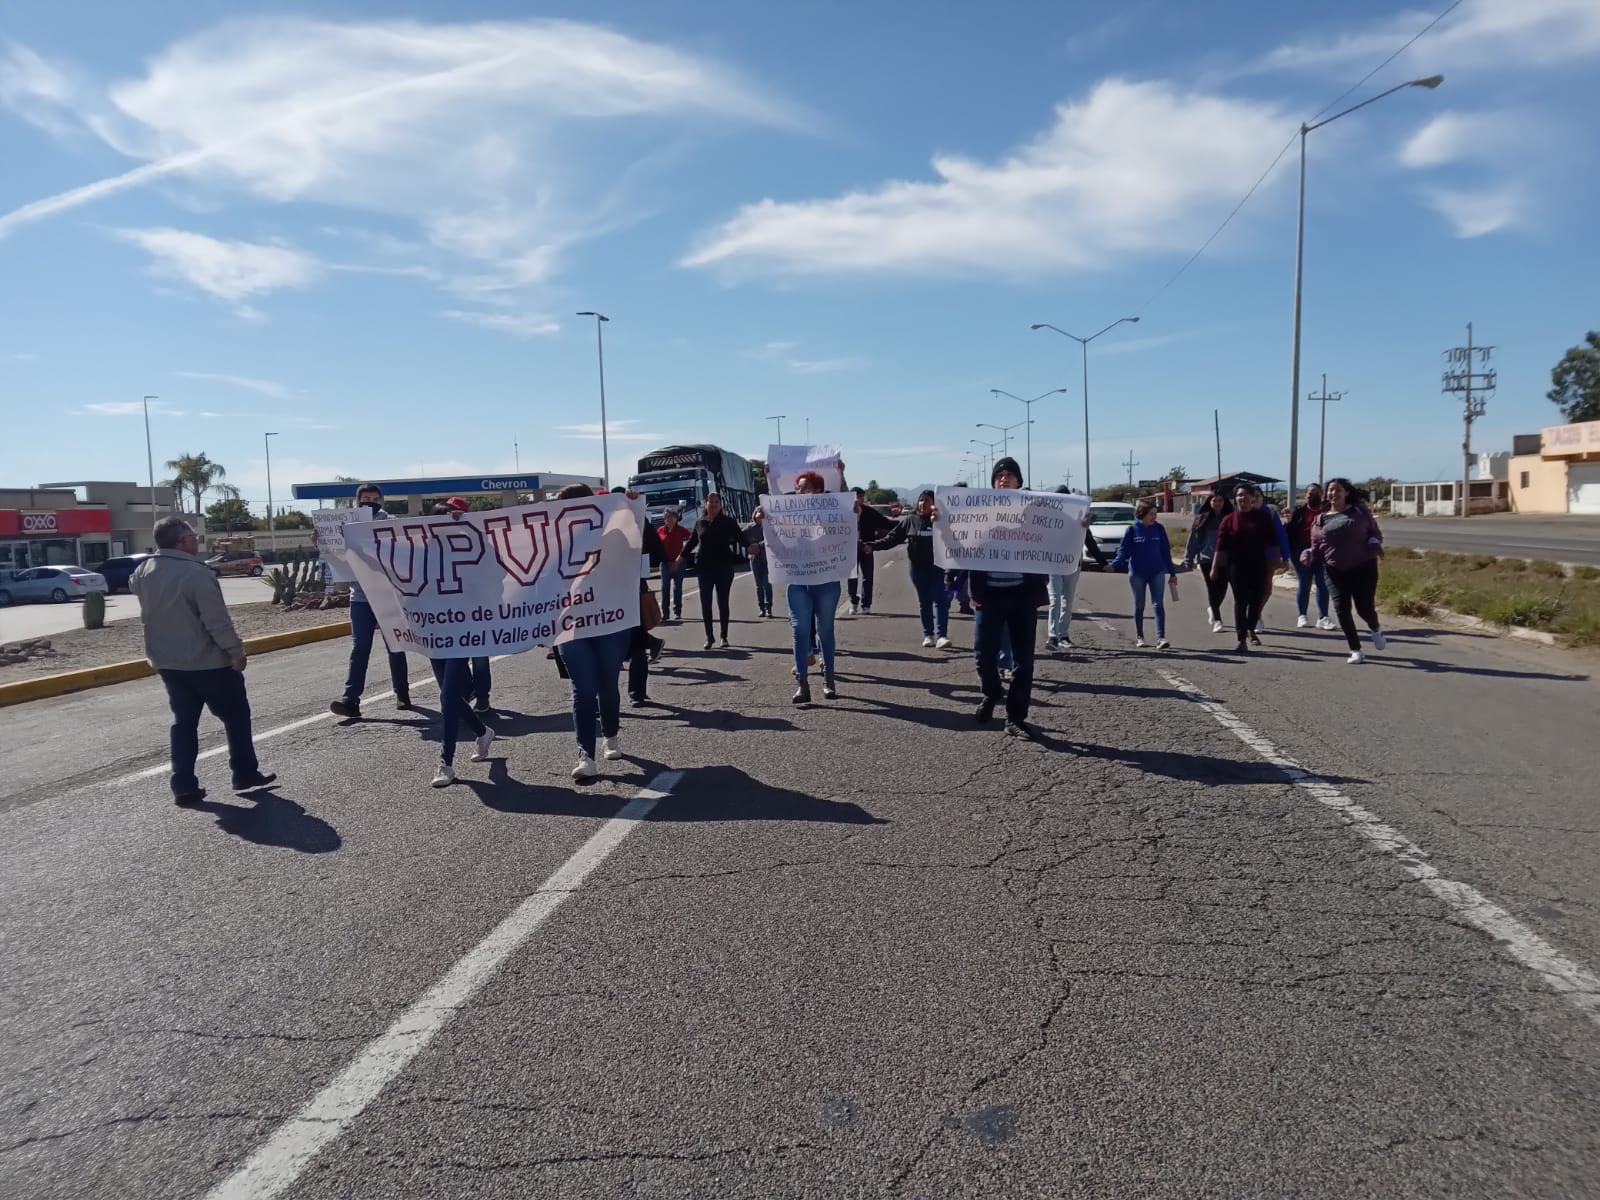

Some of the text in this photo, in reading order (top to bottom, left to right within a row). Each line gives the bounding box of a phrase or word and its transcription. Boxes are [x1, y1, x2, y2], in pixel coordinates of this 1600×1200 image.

[481, 478, 527, 490] Chevron
[769, 497, 839, 512] LA UNIVERSIDAD
[946, 495, 960, 506] NO
[966, 495, 1012, 507] QUEREMOS
[23, 514, 56, 529] OXXO
[828, 514, 846, 523] DEL
[948, 512, 1064, 529] QUEREMOS DIALOGO DIRECTO
[773, 526, 852, 538] VALLE DEL CARRIZO
[952, 529, 1043, 542] CON EL GOBERNADOR
[372, 504, 605, 597] UPVC
[989, 548, 999, 559] EN
[1001, 549, 1011, 560] SU
[1014, 549, 1075, 564] IMPARCIALIDAD
[471, 605, 493, 622] de
[498, 588, 595, 620] Universidad
[458, 630, 486, 648] del
[491, 627, 529, 646] Valle
[532, 619, 556, 641] del
[561, 606, 625, 632] Carrizo
